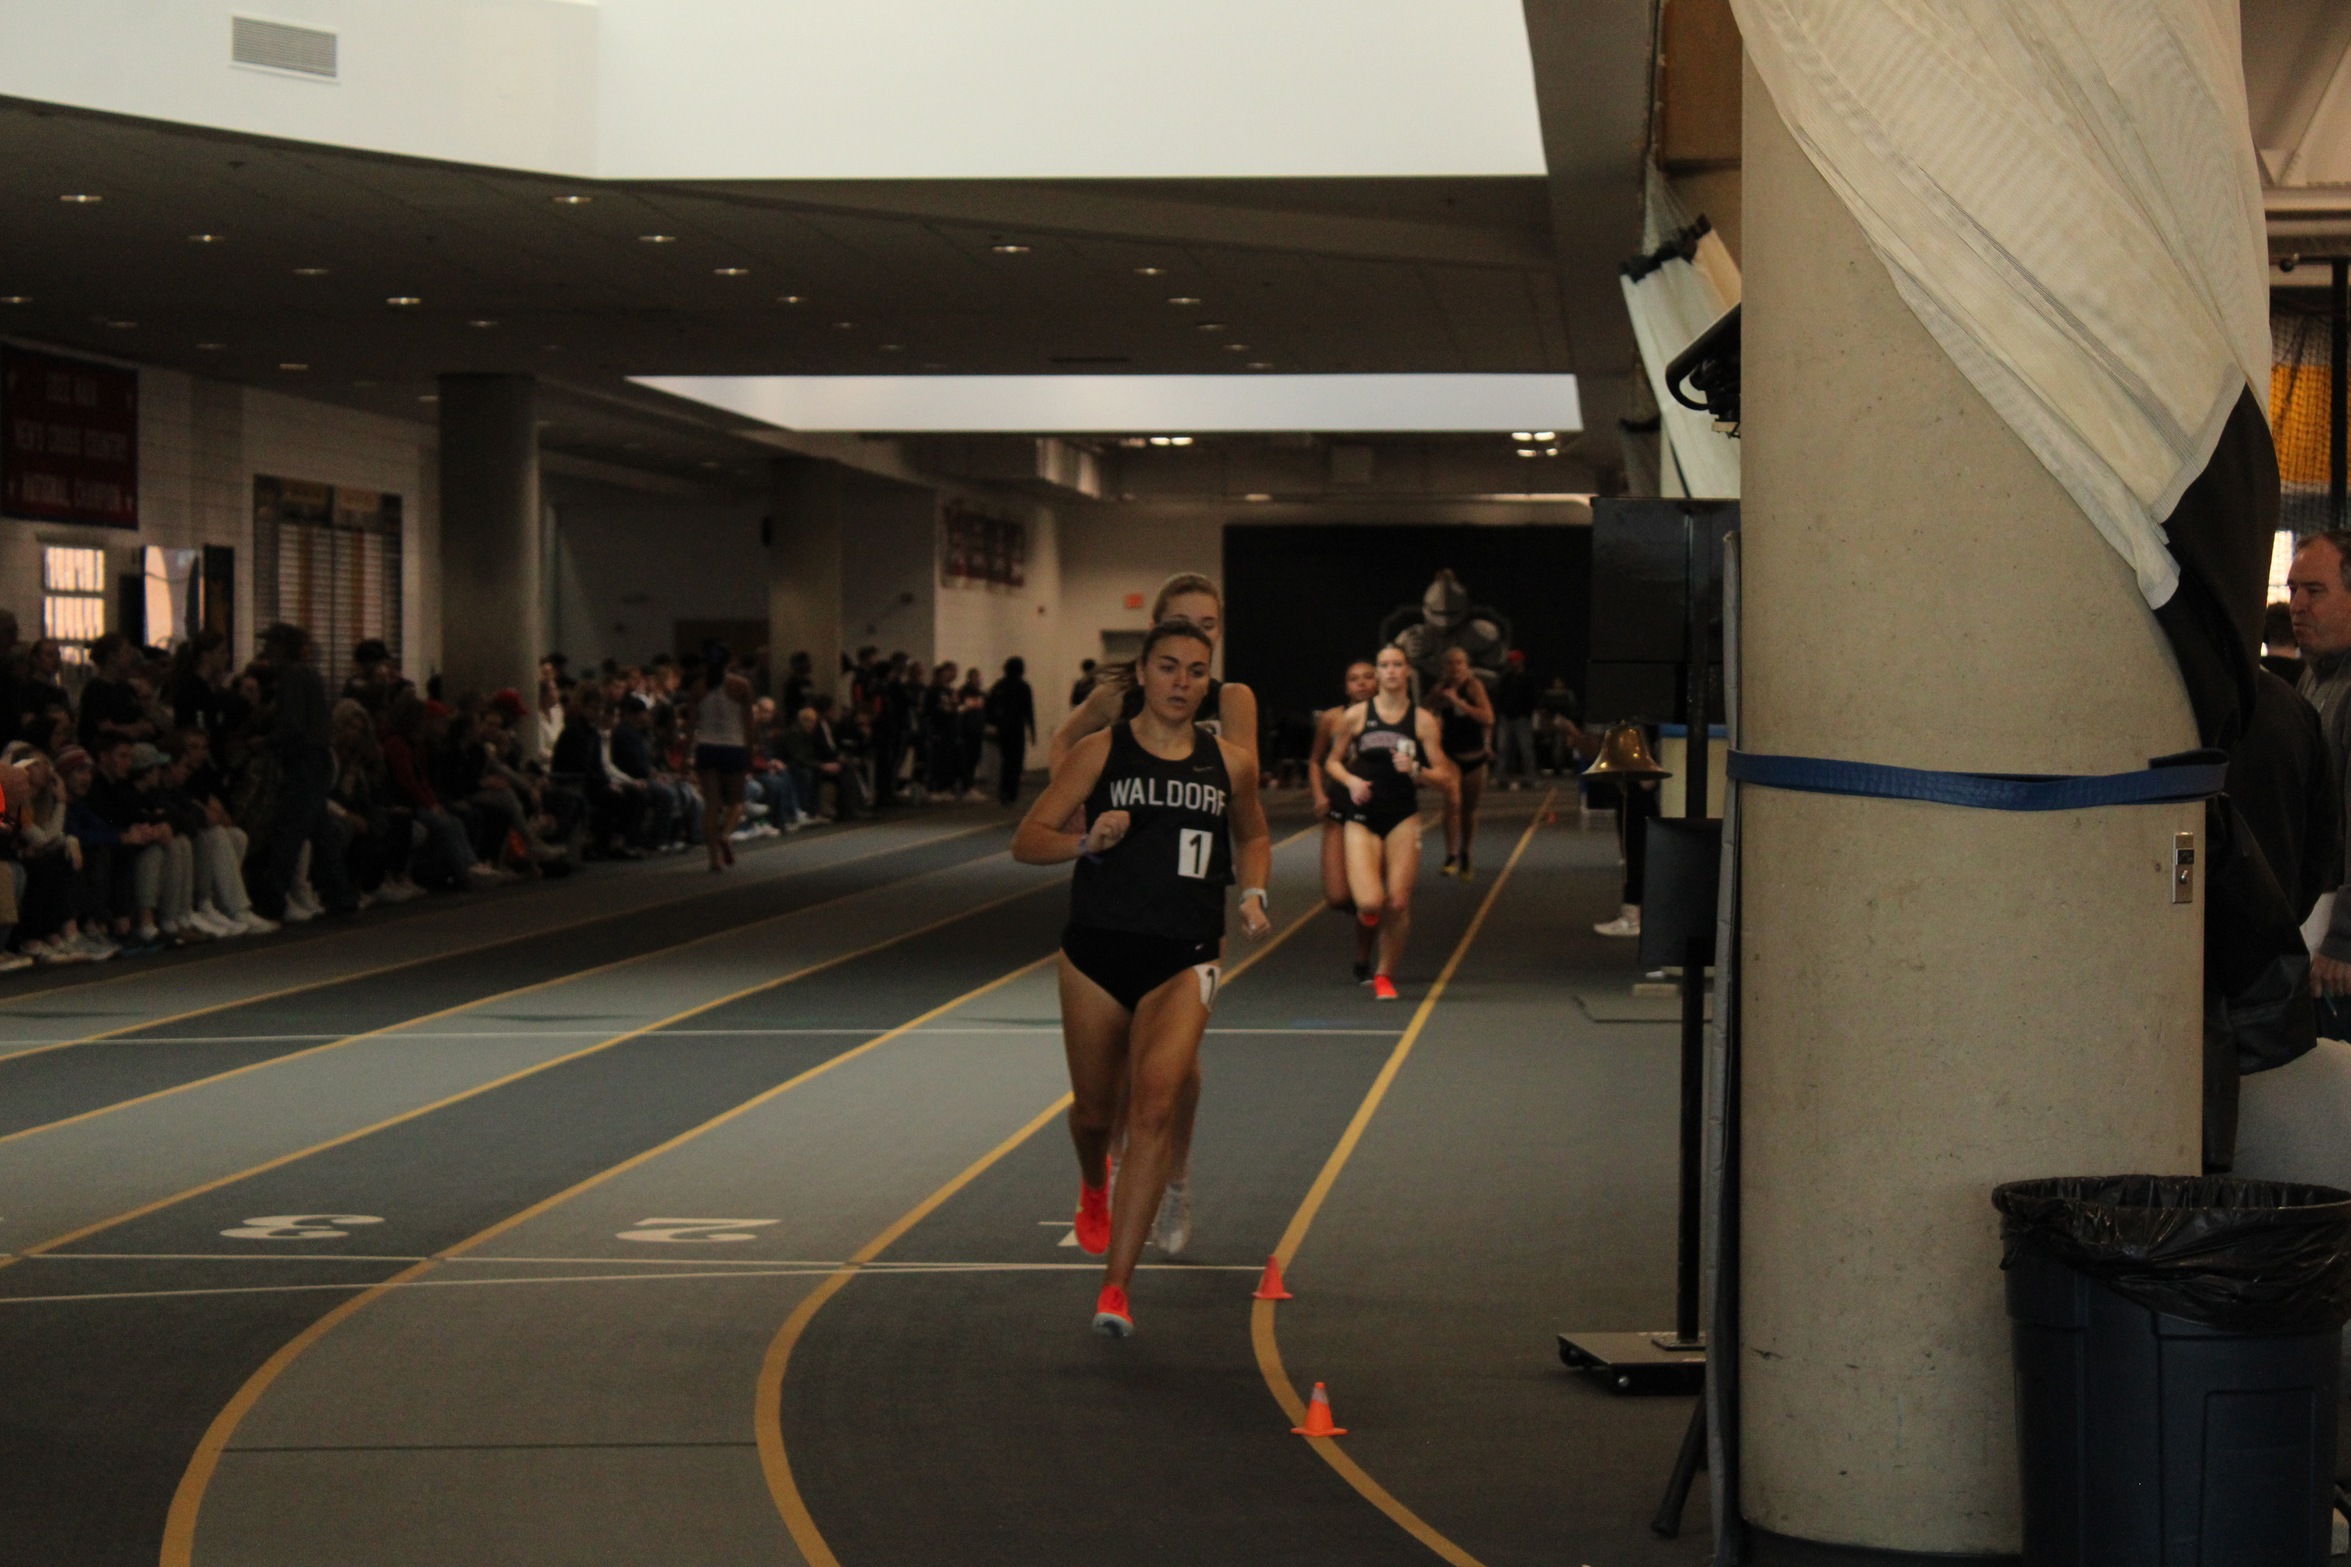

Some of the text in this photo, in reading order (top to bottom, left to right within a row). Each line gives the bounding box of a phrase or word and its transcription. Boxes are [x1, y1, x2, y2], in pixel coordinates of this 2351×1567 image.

[1109, 777, 1227, 817] WALDORF
[1189, 833, 1202, 875] 1
[219, 1214, 385, 1240] 3
[614, 1217, 782, 1243] 2
